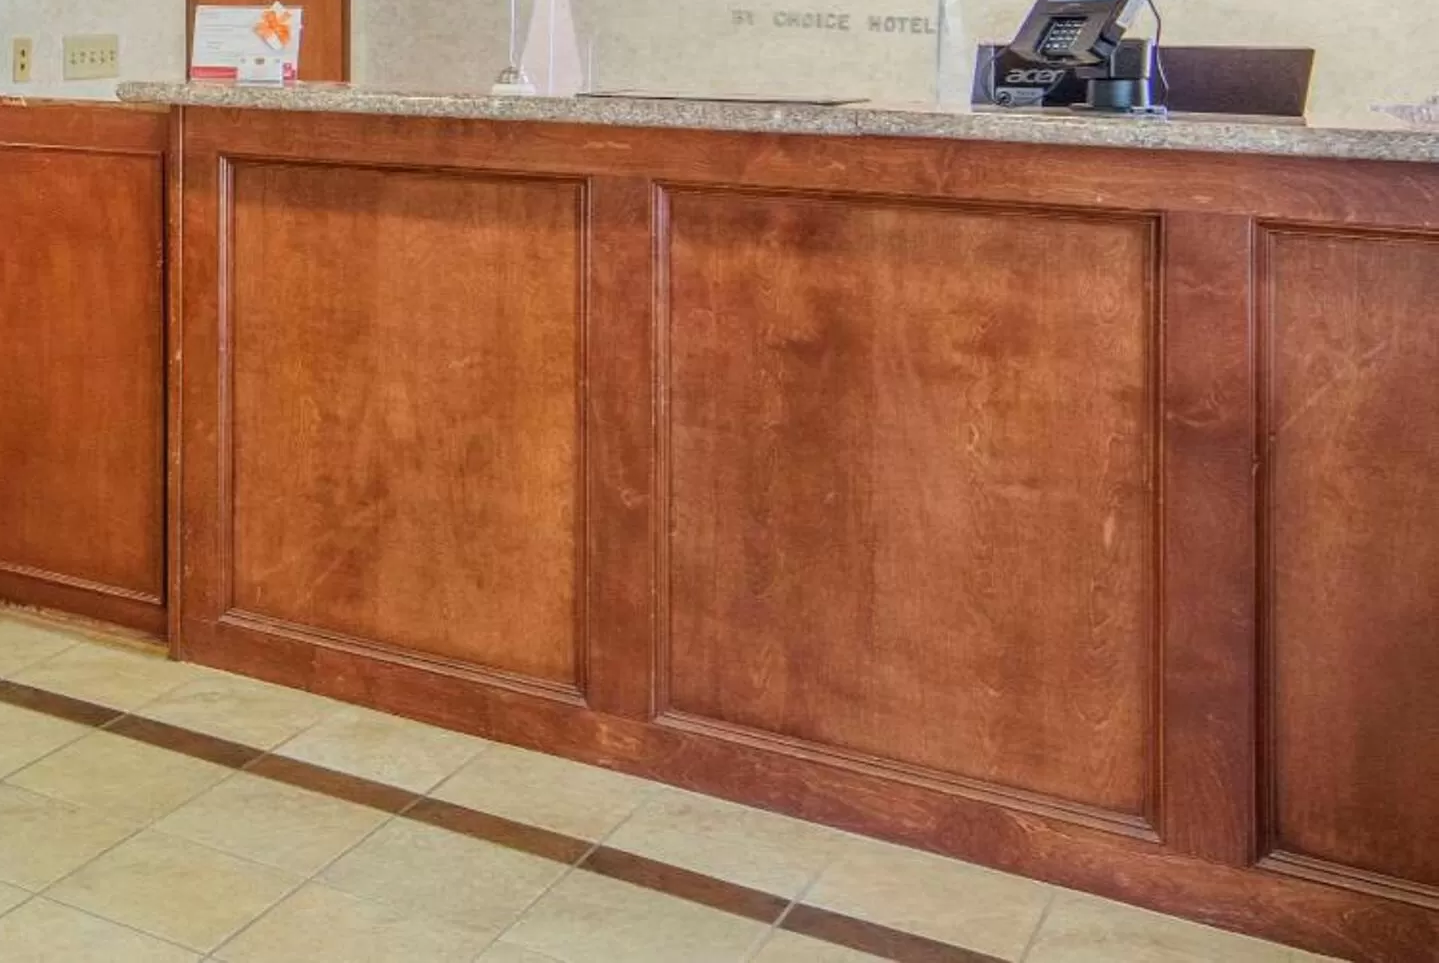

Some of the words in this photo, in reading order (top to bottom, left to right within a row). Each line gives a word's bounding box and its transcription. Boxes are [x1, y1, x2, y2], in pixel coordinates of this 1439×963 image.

[772, 10, 851, 31] CHOICE
[867, 15, 946, 35] HOTEL
[1005, 68, 1065, 83] acer
